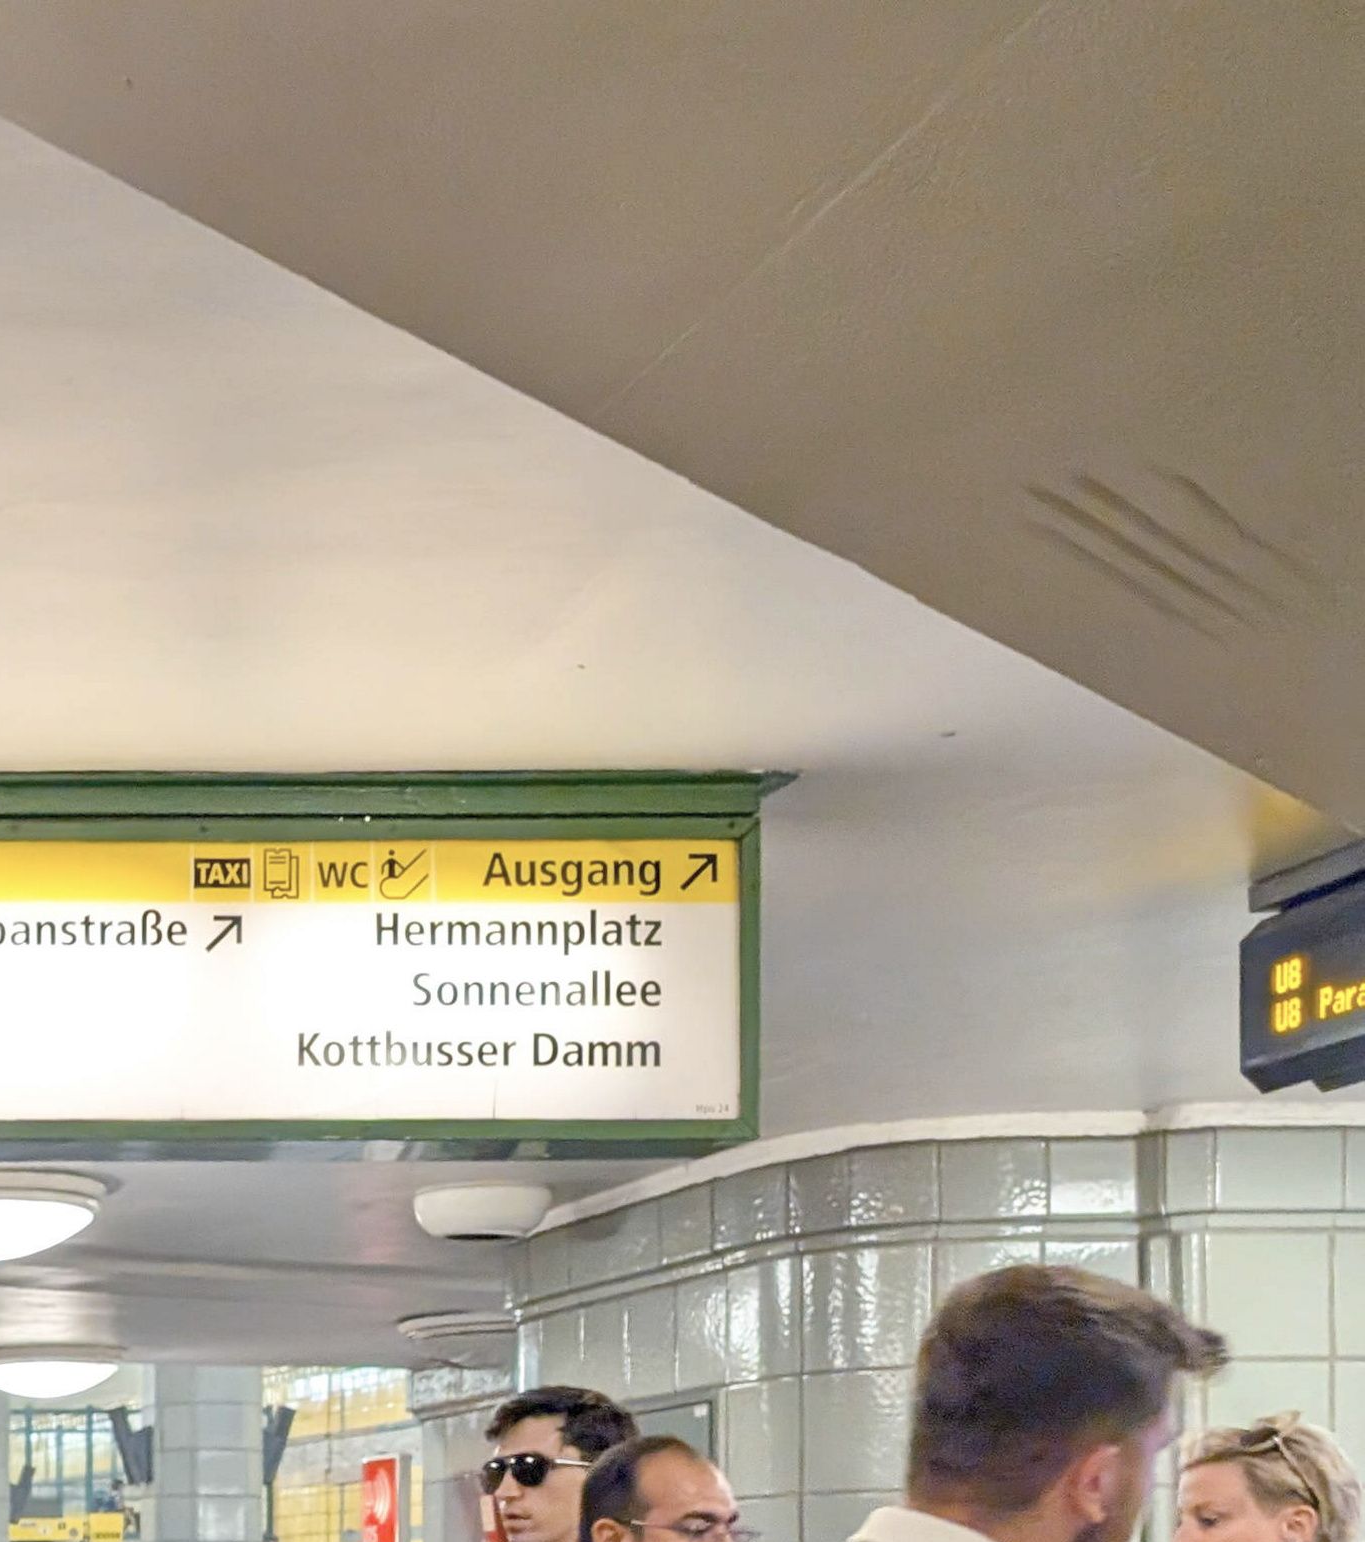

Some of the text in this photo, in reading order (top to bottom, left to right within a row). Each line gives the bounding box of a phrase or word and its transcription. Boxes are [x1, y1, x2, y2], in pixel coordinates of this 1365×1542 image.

[195, 860, 249, 887] TAXI
[317, 861, 369, 889] WC
[482, 852, 662, 896] Ausgang
[375, 910, 662, 955] Hermannplatz
[412, 970, 662, 1008] Sonnenallee
[1275, 958, 1301, 994] U8
[1275, 996, 1301, 1033] U8
[297, 1031, 662, 1069] Kottbusser Damm
